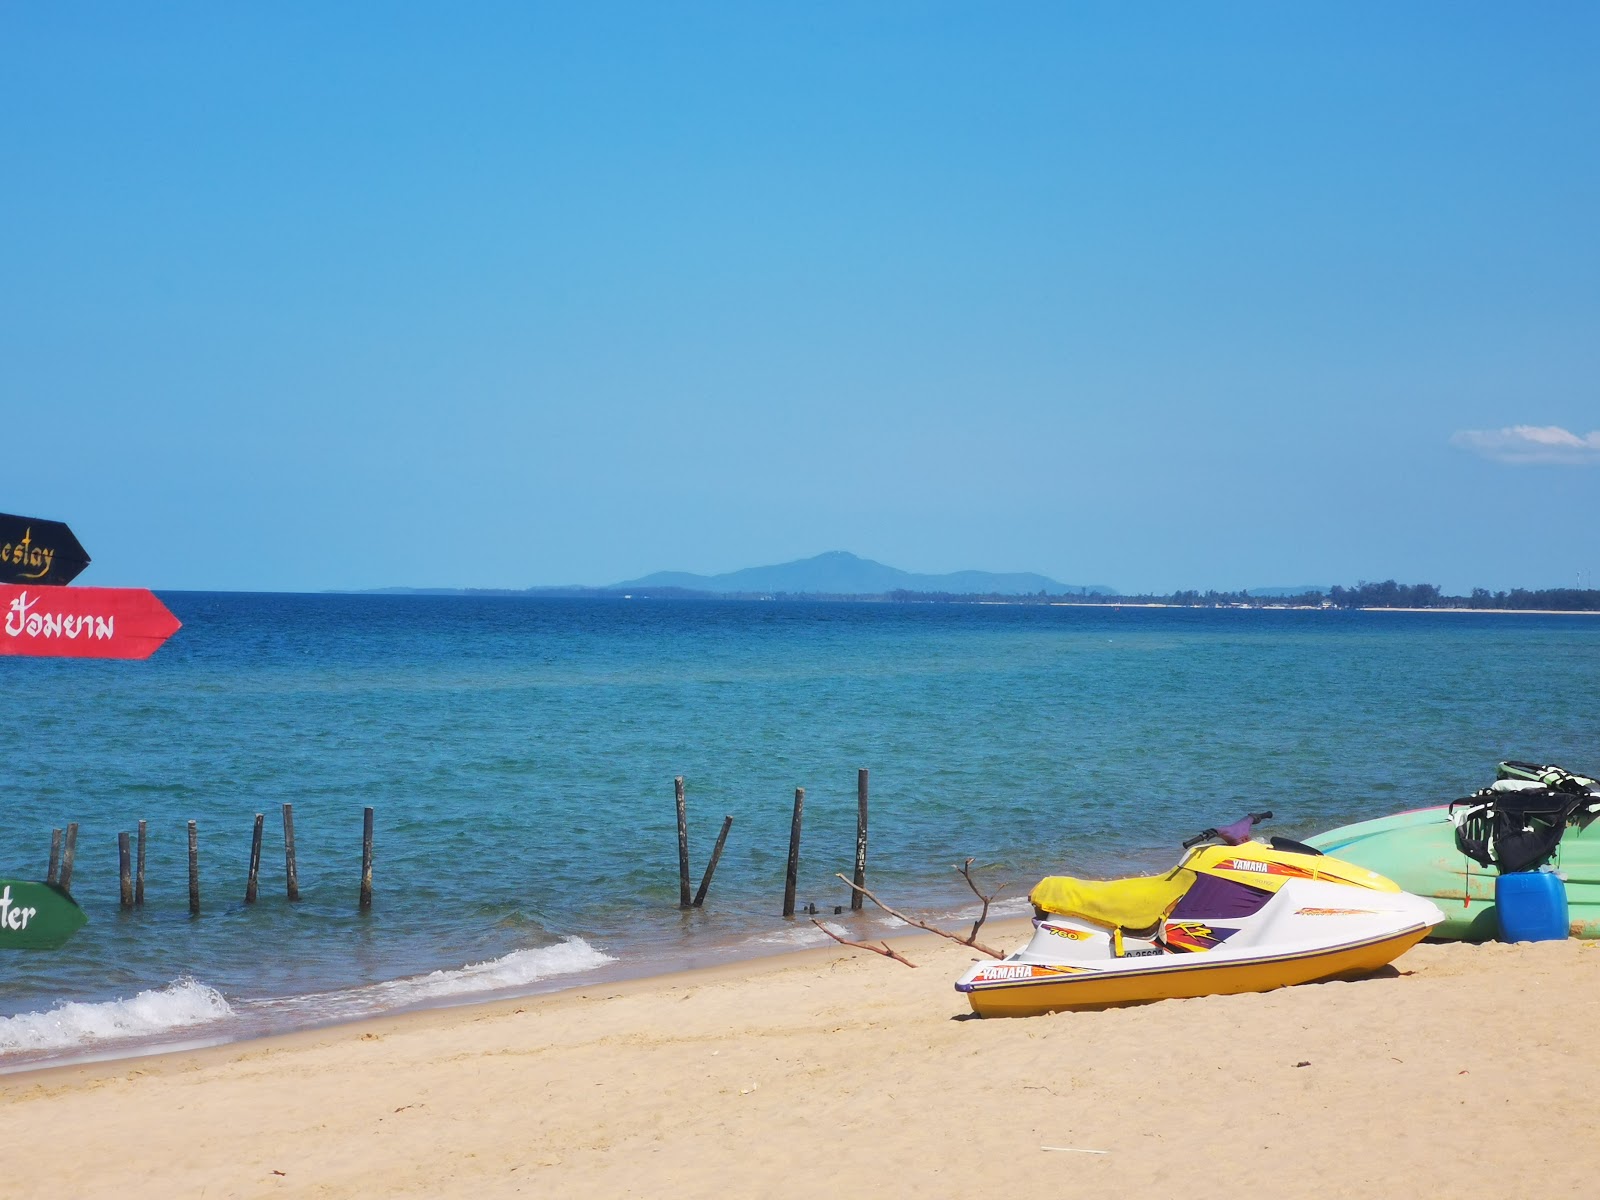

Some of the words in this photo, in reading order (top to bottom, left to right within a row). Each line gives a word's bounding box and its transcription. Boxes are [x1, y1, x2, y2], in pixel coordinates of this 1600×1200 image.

[0, 527, 55, 578] estay
[5, 590, 114, 640] ป้อมยาม
[1232, 859, 1268, 873] YAMAHA
[1049, 927, 1079, 941] 760
[982, 966, 1033, 980] YAMAHA
